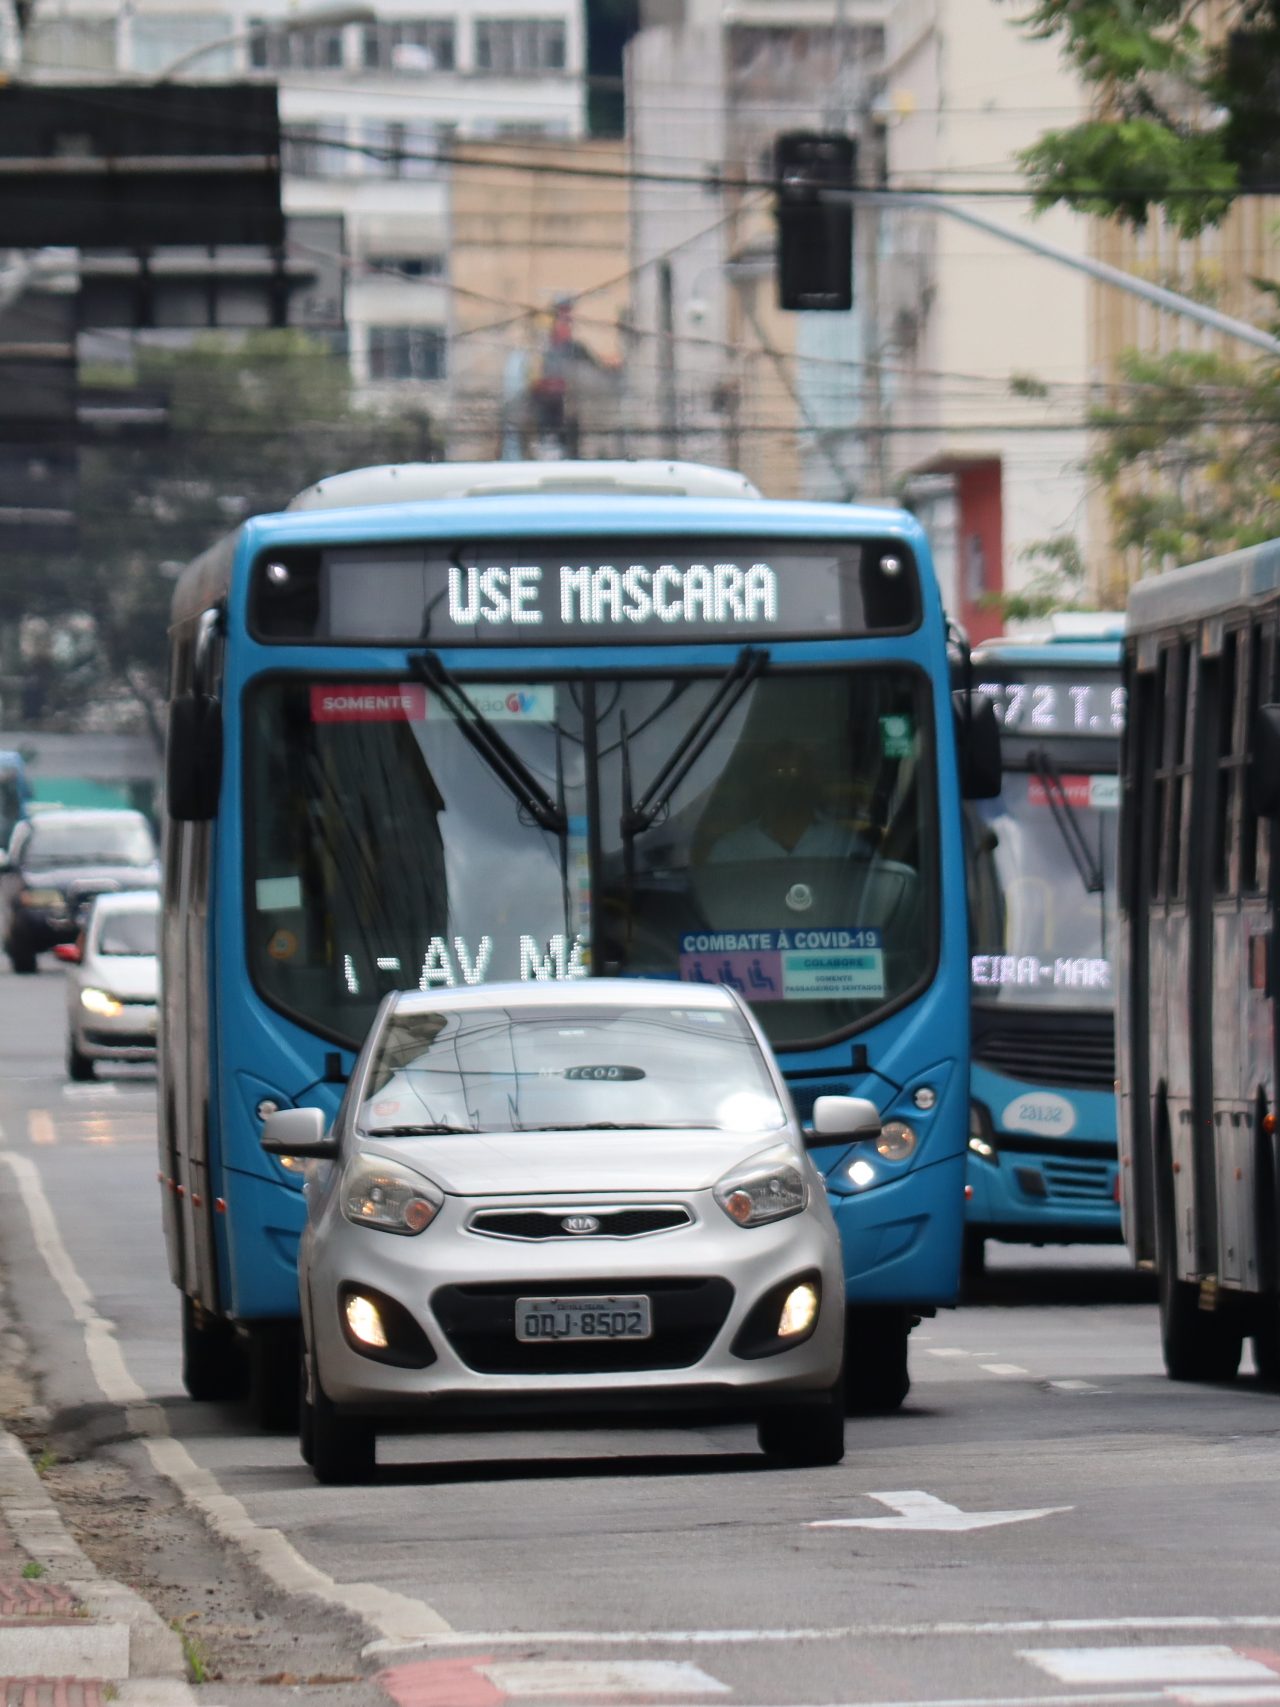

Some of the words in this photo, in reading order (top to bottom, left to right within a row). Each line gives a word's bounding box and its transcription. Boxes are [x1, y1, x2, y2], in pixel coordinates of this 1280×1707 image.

[448, 567, 544, 624] USE
[560, 563, 777, 624] MASCARA
[322, 695, 412, 710] SOMENTE
[683, 933, 771, 952] COMBATE
[776, 929, 790, 949] À
[794, 931, 877, 949] COVID-19
[419, 936, 492, 992] AV
[567, 1218, 595, 1229] KIA
